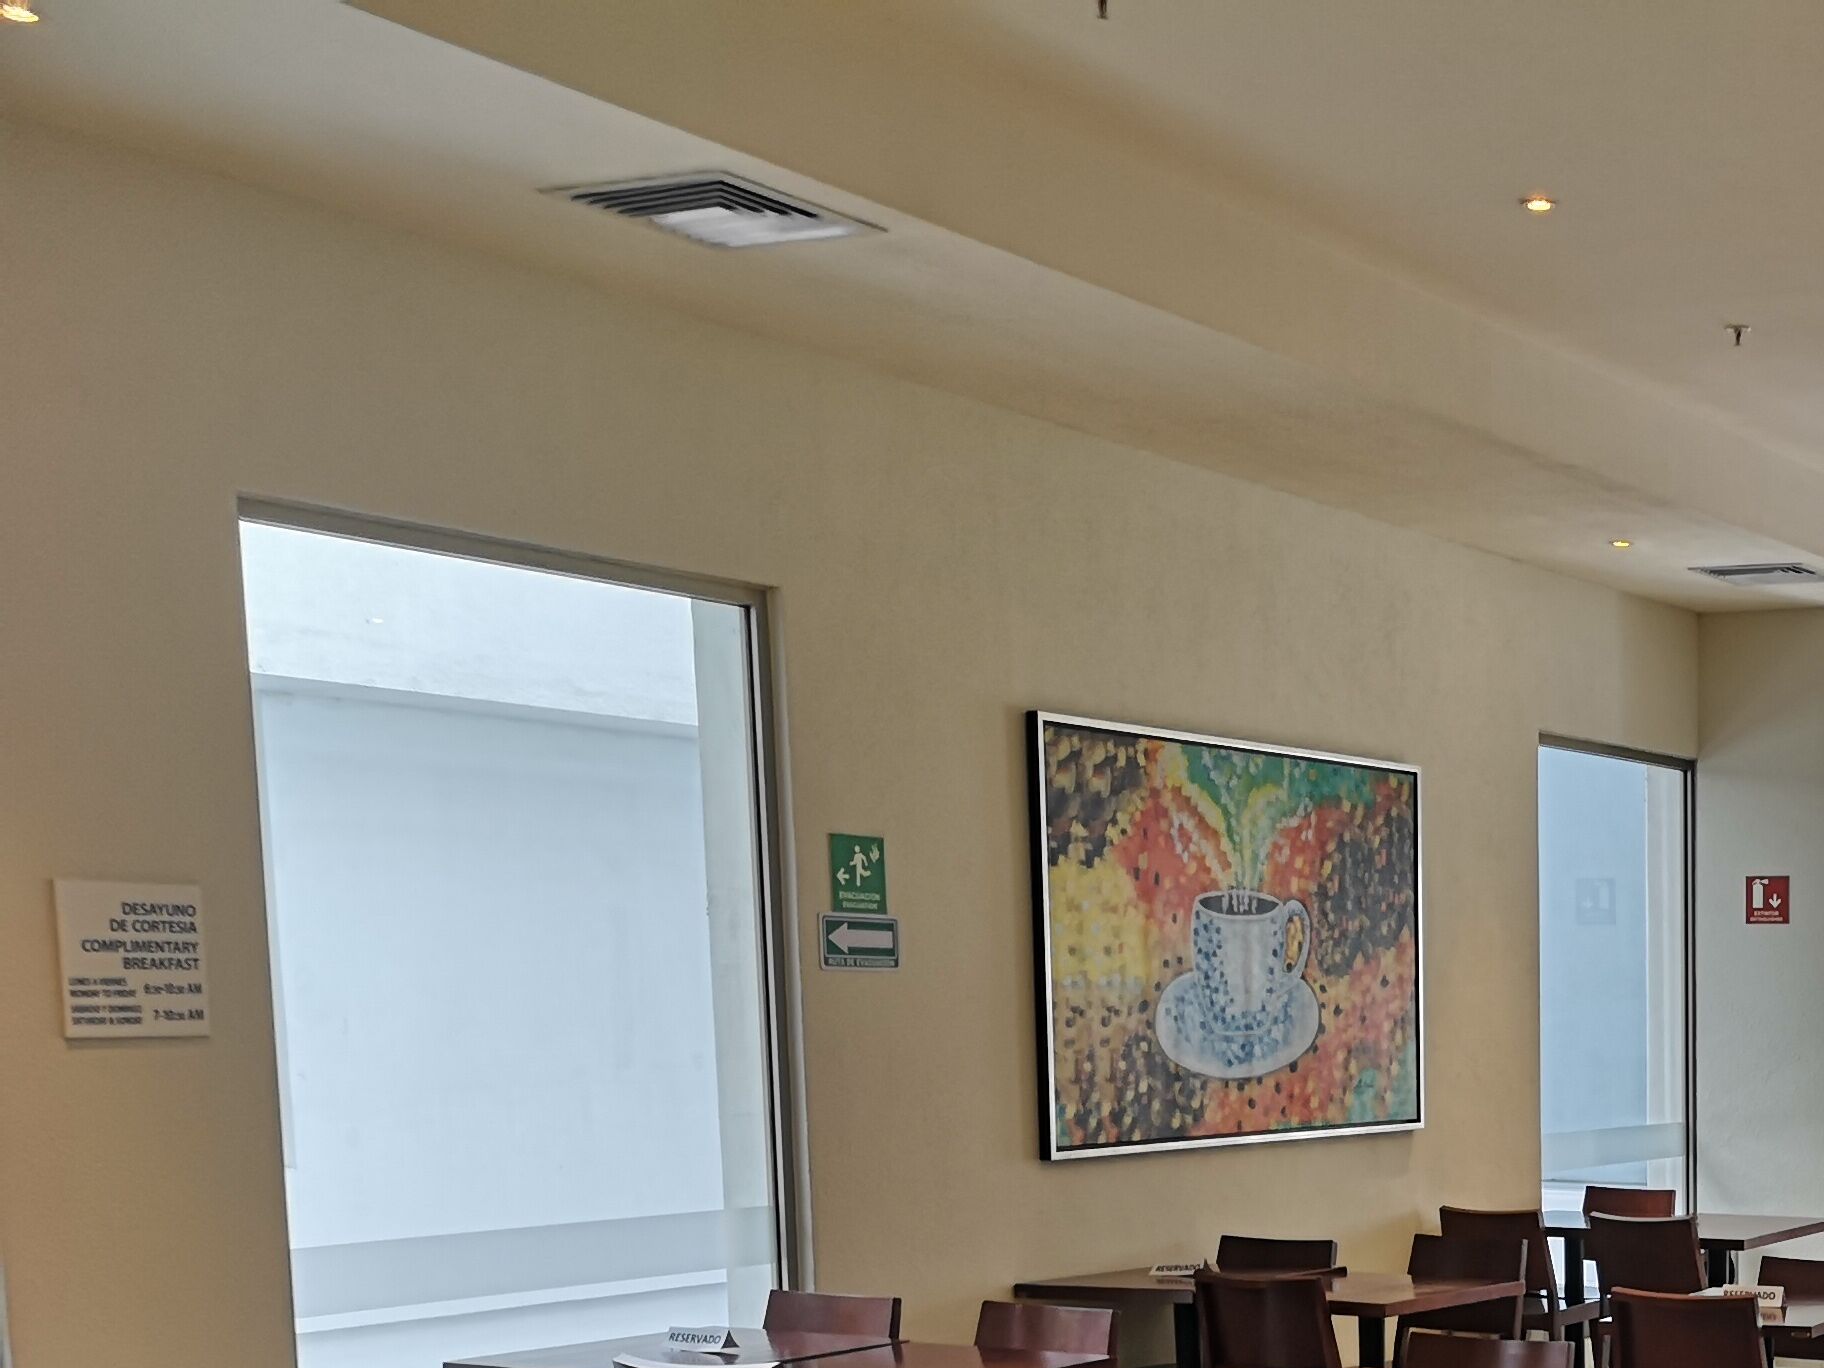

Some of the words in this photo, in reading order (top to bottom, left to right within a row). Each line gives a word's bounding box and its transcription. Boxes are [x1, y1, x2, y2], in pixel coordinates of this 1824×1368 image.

[121, 902, 197, 917] DESAYUNO
[109, 918, 129, 932] DE
[132, 919, 197, 933] CORTESIA
[81, 939, 199, 953] COMPLIMENTARY
[122, 957, 200, 970] BREAKFAST
[668, 1332, 721, 1344] RESERVADO
